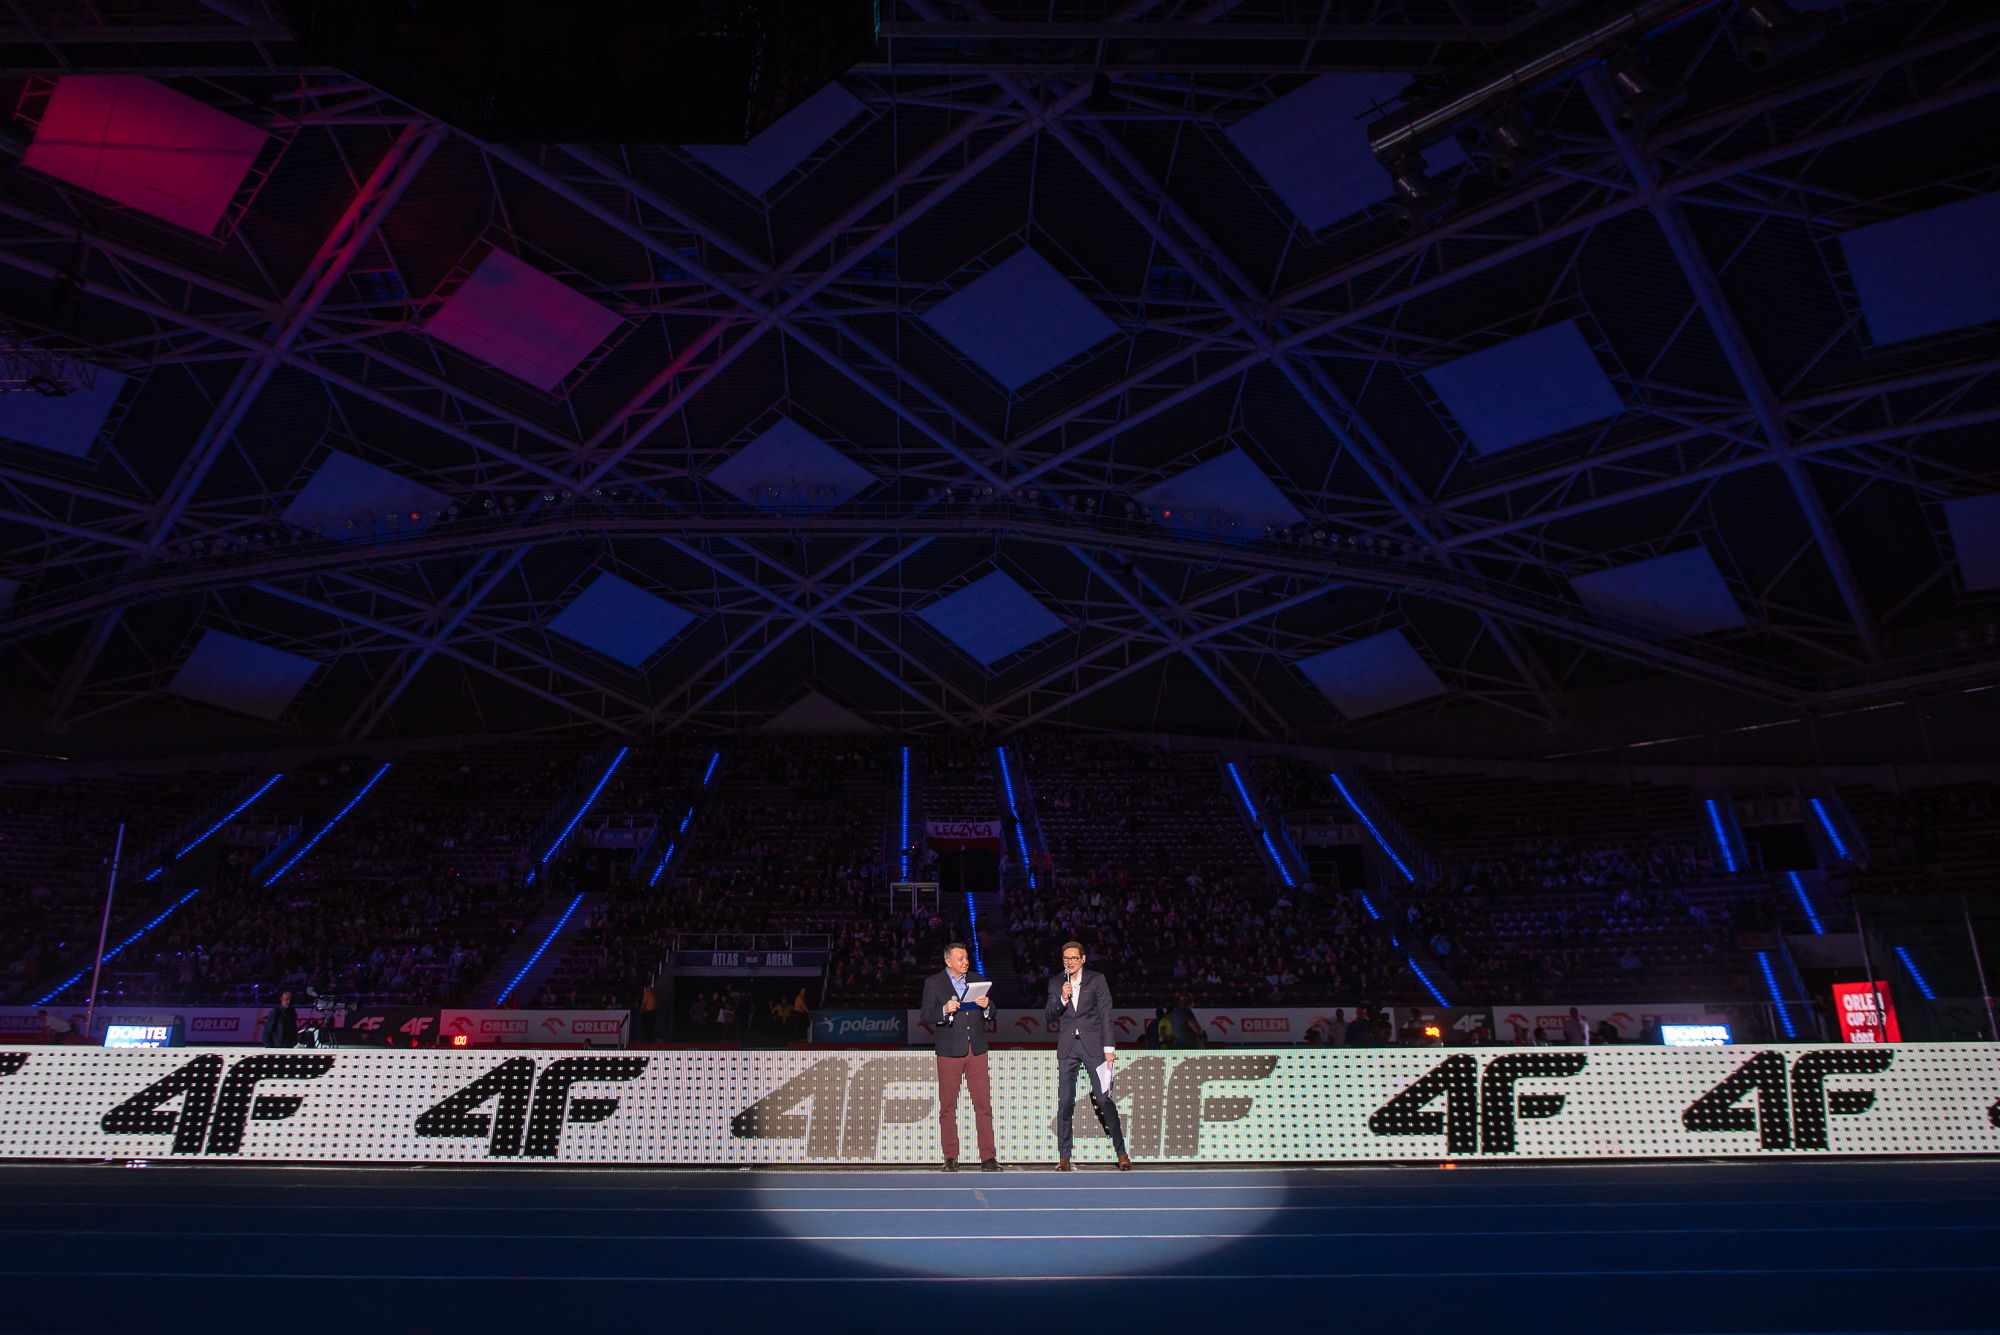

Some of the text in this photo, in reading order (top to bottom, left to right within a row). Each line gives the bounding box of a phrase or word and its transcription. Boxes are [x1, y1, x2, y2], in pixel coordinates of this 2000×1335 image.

[711, 953, 793, 966] ATLAS ARENA
[116, 1015, 154, 1024] TYCZKA
[194, 1019, 237, 1030] ORLEN
[399, 1017, 434, 1035] 4F
[482, 1021, 526, 1032] ORLEN
[575, 1021, 618, 1033] ORLEN
[839, 1016, 901, 1035] polanik
[1243, 1019, 1288, 1031] ORLEN
[1453, 1014, 1486, 1032] 4F
[1539, 1017, 1567, 1028] ORL
[1846, 1012, 1865, 1026] CUP
[108, 1026, 167, 1040] DOMTEL
[100, 1053, 335, 1153] 4F
[414, 1056, 650, 1157] 4F
[730, 1056, 938, 1158] 4F
[1051, 1055, 1280, 1158] 4F
[1368, 1052, 1587, 1154] 4F
[1681, 1049, 1894, 1149] 4F
